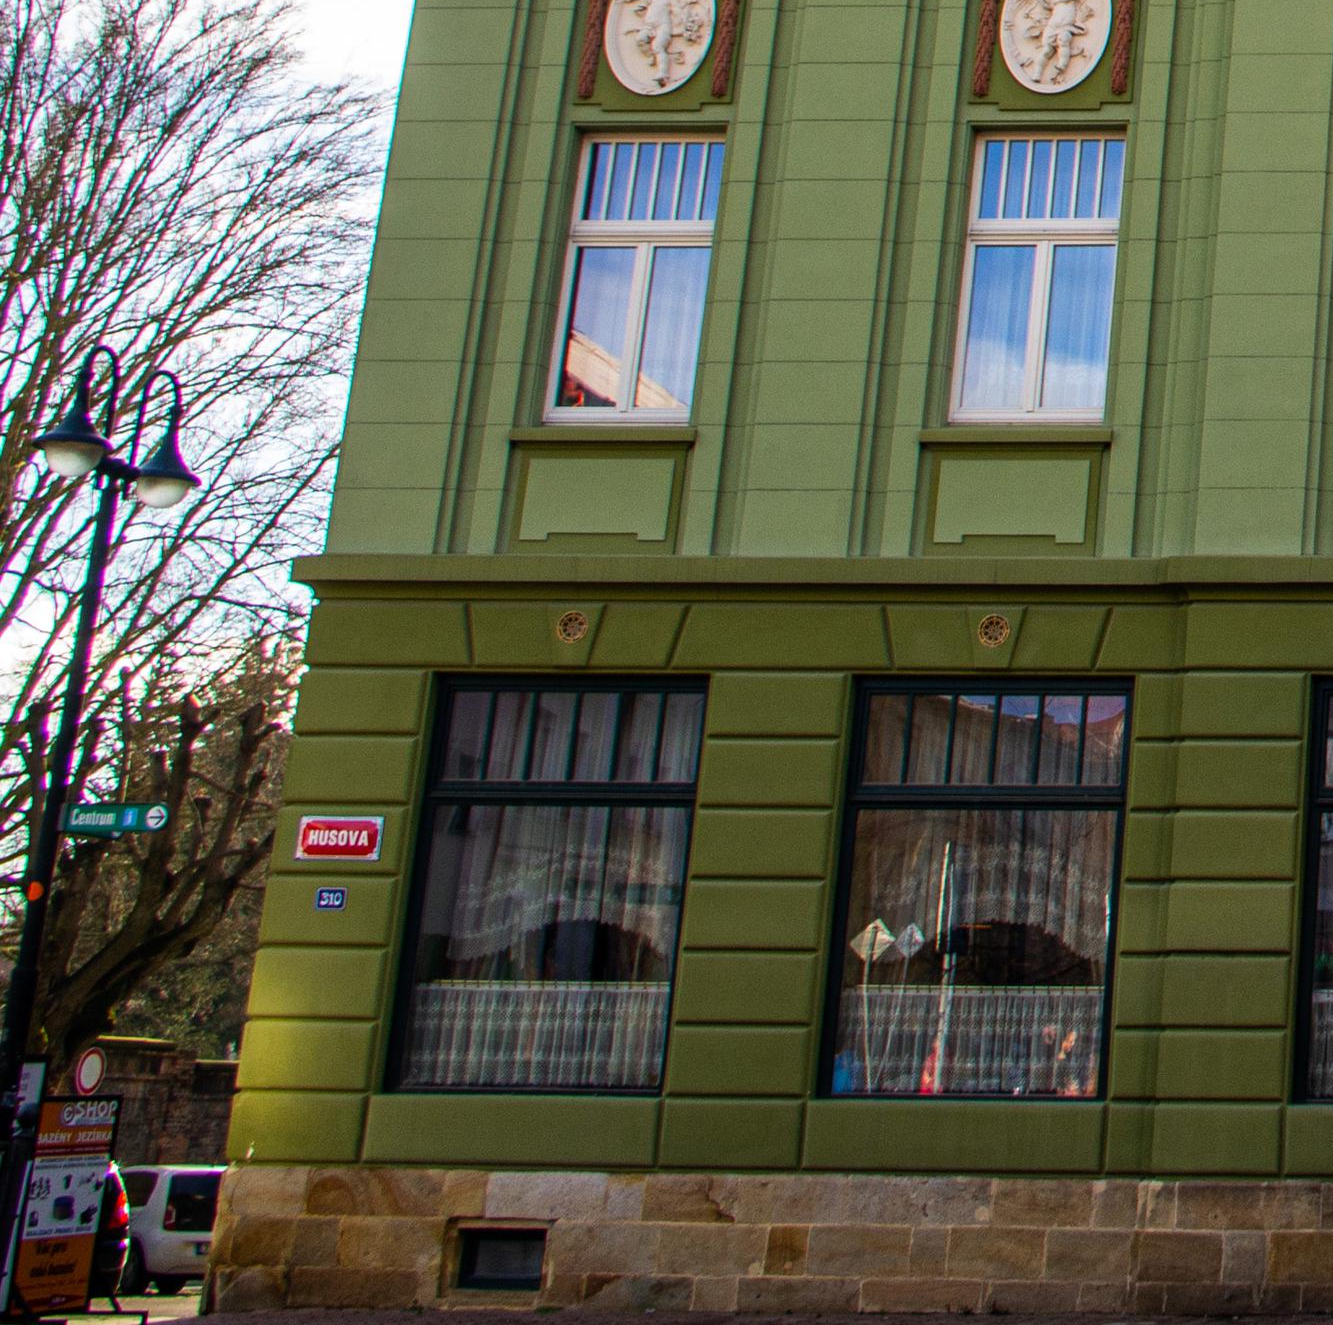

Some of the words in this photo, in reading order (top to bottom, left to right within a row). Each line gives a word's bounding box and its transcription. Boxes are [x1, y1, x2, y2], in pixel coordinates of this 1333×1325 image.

[69, 808, 117, 826] Centrum
[308, 829, 369, 847] HUSOVA
[319, 891, 343, 906] 310
